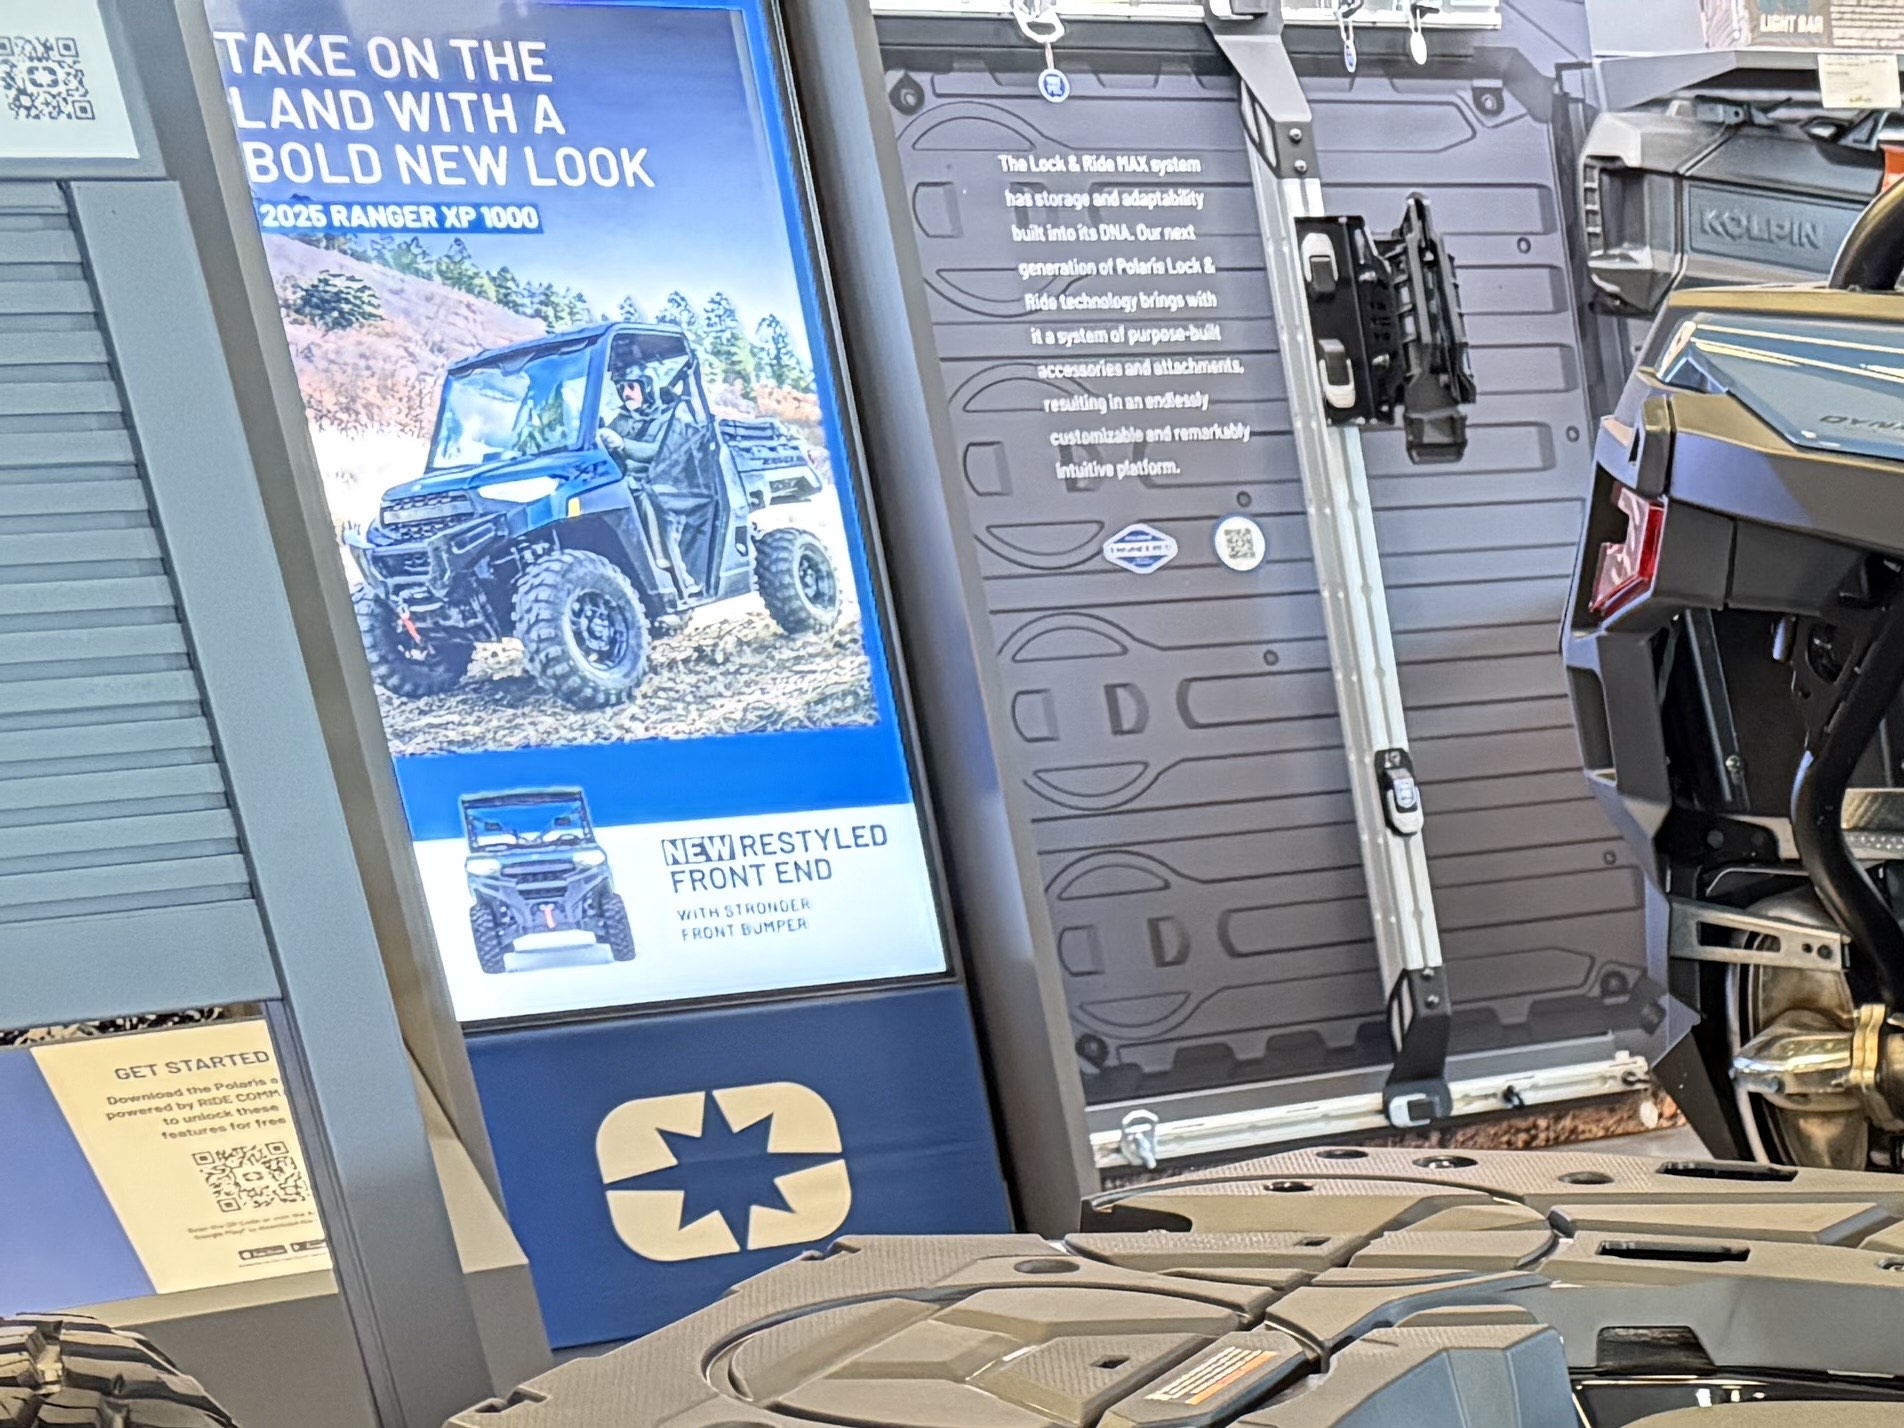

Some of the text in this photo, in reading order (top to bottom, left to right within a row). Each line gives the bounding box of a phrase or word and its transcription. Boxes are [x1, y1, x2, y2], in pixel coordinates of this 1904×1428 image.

[213, 31, 553, 84] TAKE ON THE
[229, 86, 566, 135] LAND WITH A
[242, 140, 655, 188] BOLD NEW LOOK
[998, 155, 1200, 176] The Lock & Ride MAX system
[1005, 189, 1204, 210] has storage and adaptability
[260, 204, 538, 229] 2025 RANGER XP 1000
[1012, 224, 1045, 241] built
[1047, 225, 1076, 241] into
[1077, 224, 1097, 241] its
[1136, 224, 1161, 240] Our
[1164, 225, 1195, 240] next
[1702, 209, 1822, 249] KOLPIN
[1018, 257, 1216, 279] generation of Polaris Lock &
[1025, 291, 1217, 312] Ride technology brings with
[1057, 328, 1108, 347] system
[1110, 325, 1125, 342] of
[1128, 324, 1221, 345] purpose-built
[1037, 361, 1122, 378] accessories
[1125, 359, 1151, 376] and
[1044, 394, 1106, 414] resulting
[1126, 396, 1143, 409] an
[1146, 391, 1208, 410] endlessly
[1050, 423, 1250, 446] customizable and remarkably
[1056, 460, 1114, 479] intuitive
[663, 824, 888, 866] NEW RESTYLED
[670, 858, 832, 894] FRONT END
[677, 906, 719, 921] WITH
[681, 918, 808, 941] FRONT BUMPER
[114, 1050, 270, 1080] GET STARTED
[106, 1088, 183, 1106] Download
[187, 1084, 212, 1096] the
[214, 1077, 267, 1093] Polaris
[105, 1103, 172, 1122] powered
[176, 1098, 194, 1114] by
[197, 1095, 233, 1108] RIDE
[162, 1105, 280, 1127] to unlock these
[161, 1117, 287, 1140] features for free
